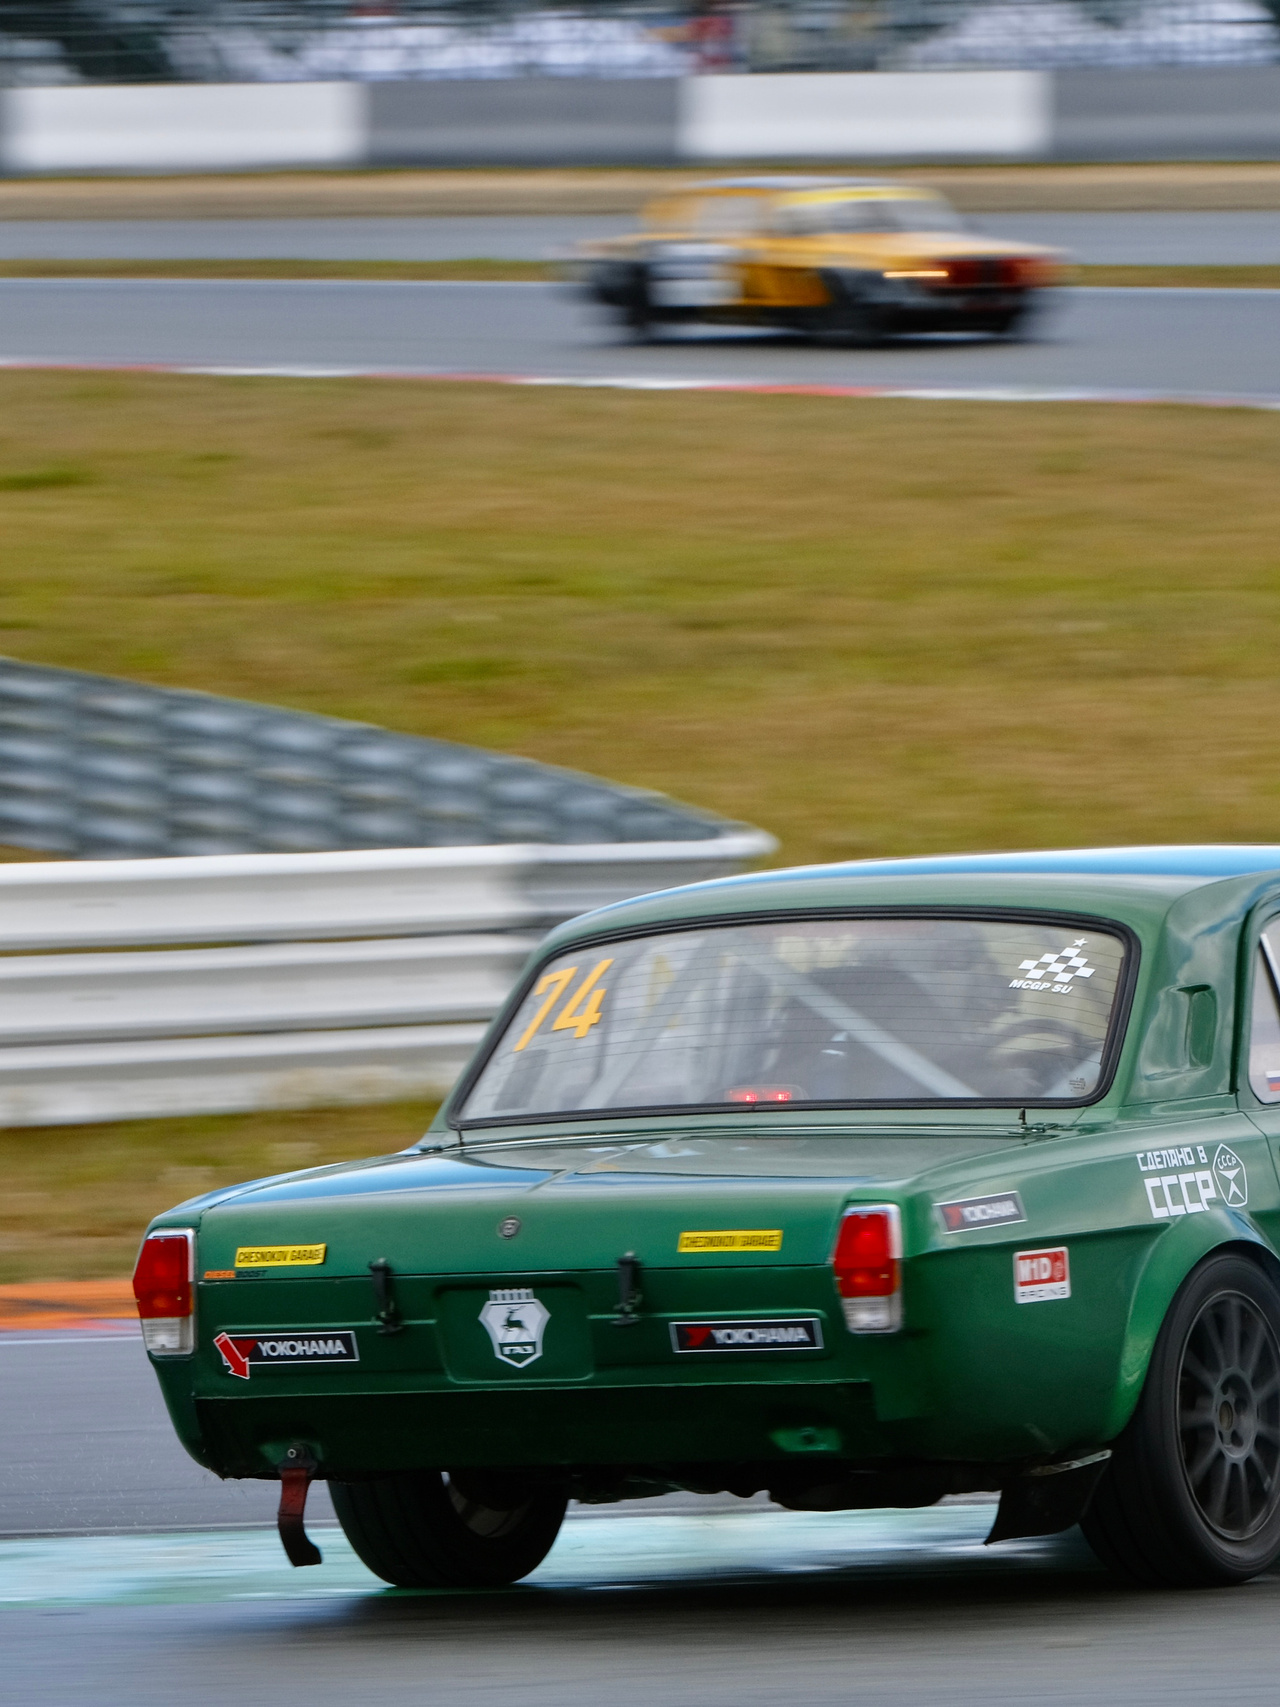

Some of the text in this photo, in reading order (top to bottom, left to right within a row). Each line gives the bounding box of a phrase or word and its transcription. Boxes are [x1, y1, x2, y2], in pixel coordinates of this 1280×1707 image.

[1008, 979, 1074, 994] MCGP SU
[513, 958, 615, 1052] 74
[1136, 1147, 1196, 1172] СДЕЛАНО
[1217, 1154, 1237, 1170] СССР
[1143, 1170, 1217, 1219] СССР
[237, 1251, 289, 1264] CHESNOKOV
[710, 1326, 812, 1345] YOKOHAMA
[257, 1340, 348, 1357] YOKOHAMA
